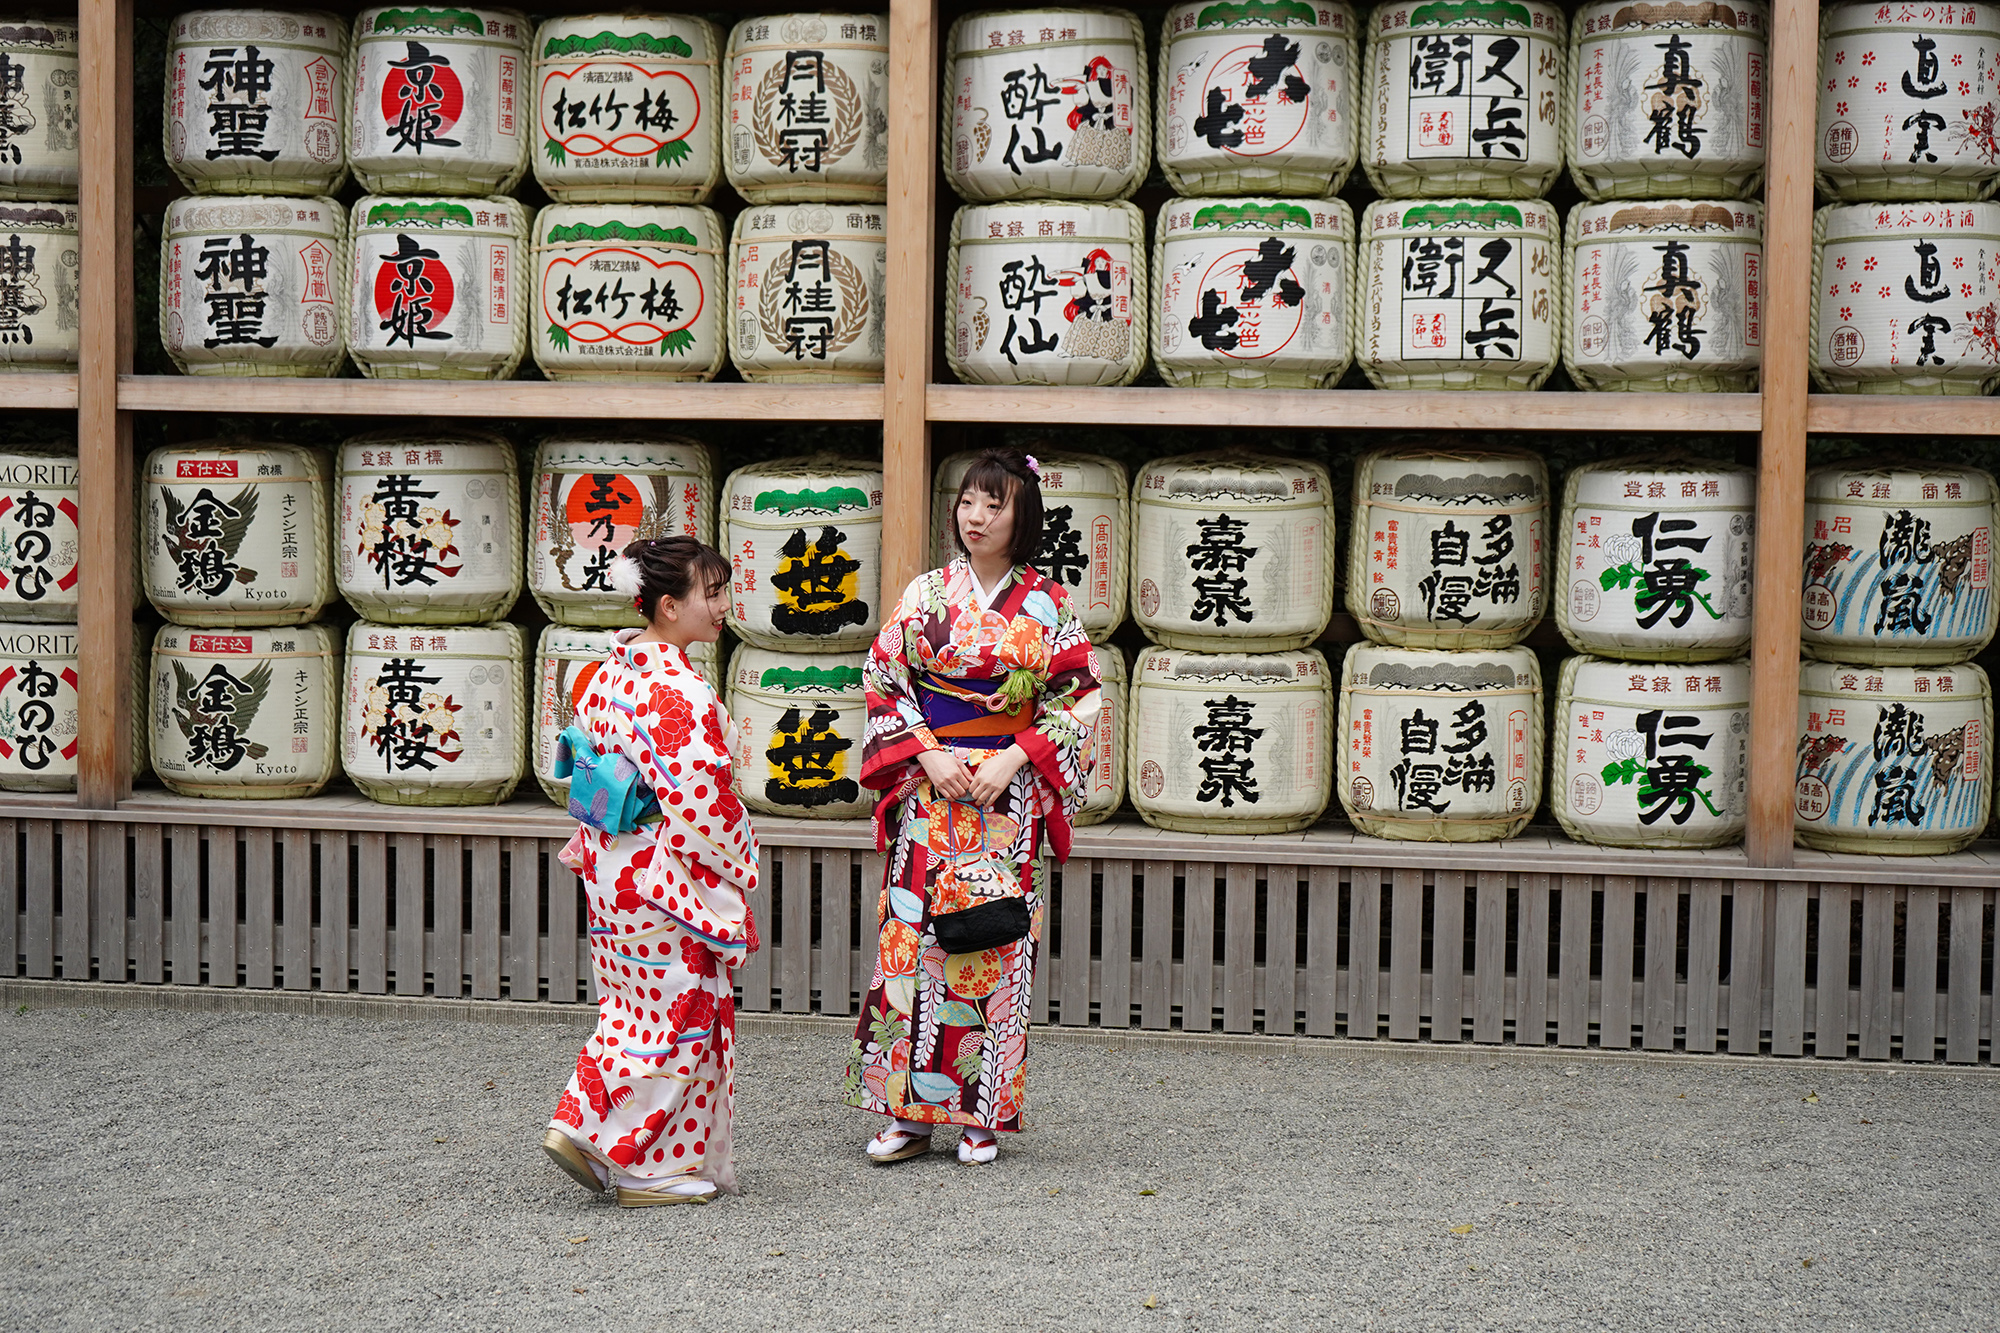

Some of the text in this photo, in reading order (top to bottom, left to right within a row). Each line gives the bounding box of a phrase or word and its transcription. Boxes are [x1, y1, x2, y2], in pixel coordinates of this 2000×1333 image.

[841, 24, 877, 41] 商標
[1040, 28, 1077, 42] 商標
[1875, 5, 1976, 25] 熊谷の清酒
[198, 45, 281, 162] 神聖
[386, 41, 462, 155] 京姫
[553, 87, 679, 135] 松竹梅
[777, 50, 830, 173] 月桂冠
[1116, 74, 1129, 121] 清酒
[1194, 34, 1310, 149] 大七
[1538, 48, 1557, 126] 地酒
[1643, 34, 1708, 160] 真鶴
[1001, 63, 1063, 176] 酔仙
[476, 211, 508, 228] 商標
[847, 213, 882, 230] 商標
[1038, 220, 1077, 236] 商標
[1875, 209, 1974, 229] 熊谷の清酒
[194, 233, 279, 349] 神聖
[379, 233, 453, 349] 京姫
[556, 274, 683, 322] 松竹梅
[783, 240, 836, 360] 月桂冠
[999, 255, 1059, 365] 酔仙
[1114, 266, 1128, 312] 清酒
[1188, 237, 1305, 351] 大七
[1531, 245, 1550, 323] 地酒
[1643, 240, 1707, 361] 真鶴
[180, 463, 234, 476] 京仕込
[405, 450, 443, 465] 商標
[1042, 472, 1063, 489] 標
[1681, 481, 1720, 497] 商標
[1847, 480, 1961, 499] 登録 商標
[12, 490, 55, 600] ねのひ
[282, 494, 298, 559] キンシ正宗
[372, 474, 440, 590] 黄桜
[245, 588, 287, 600] Kyoto
[1186, 513, 1259, 627] 嘉泉
[1632, 512, 1713, 630] 仁勇
[1817, 592, 1829, 622] 高知
[194, 637, 248, 652] 京仕込
[410, 636, 447, 651] 商標
[293, 669, 308, 734] キンシ正宗
[1685, 676, 1722, 692] 商標
[1840, 674, 1953, 692] 登録 商標
[15, 660, 58, 770] ねのひ
[376, 658, 443, 774] 黄桜
[256, 763, 297, 776] Kyoto
[1193, 694, 1265, 808] 嘉泉
[1636, 710, 1714, 826] 仁勇
[1811, 784, 1822, 813] 高知
